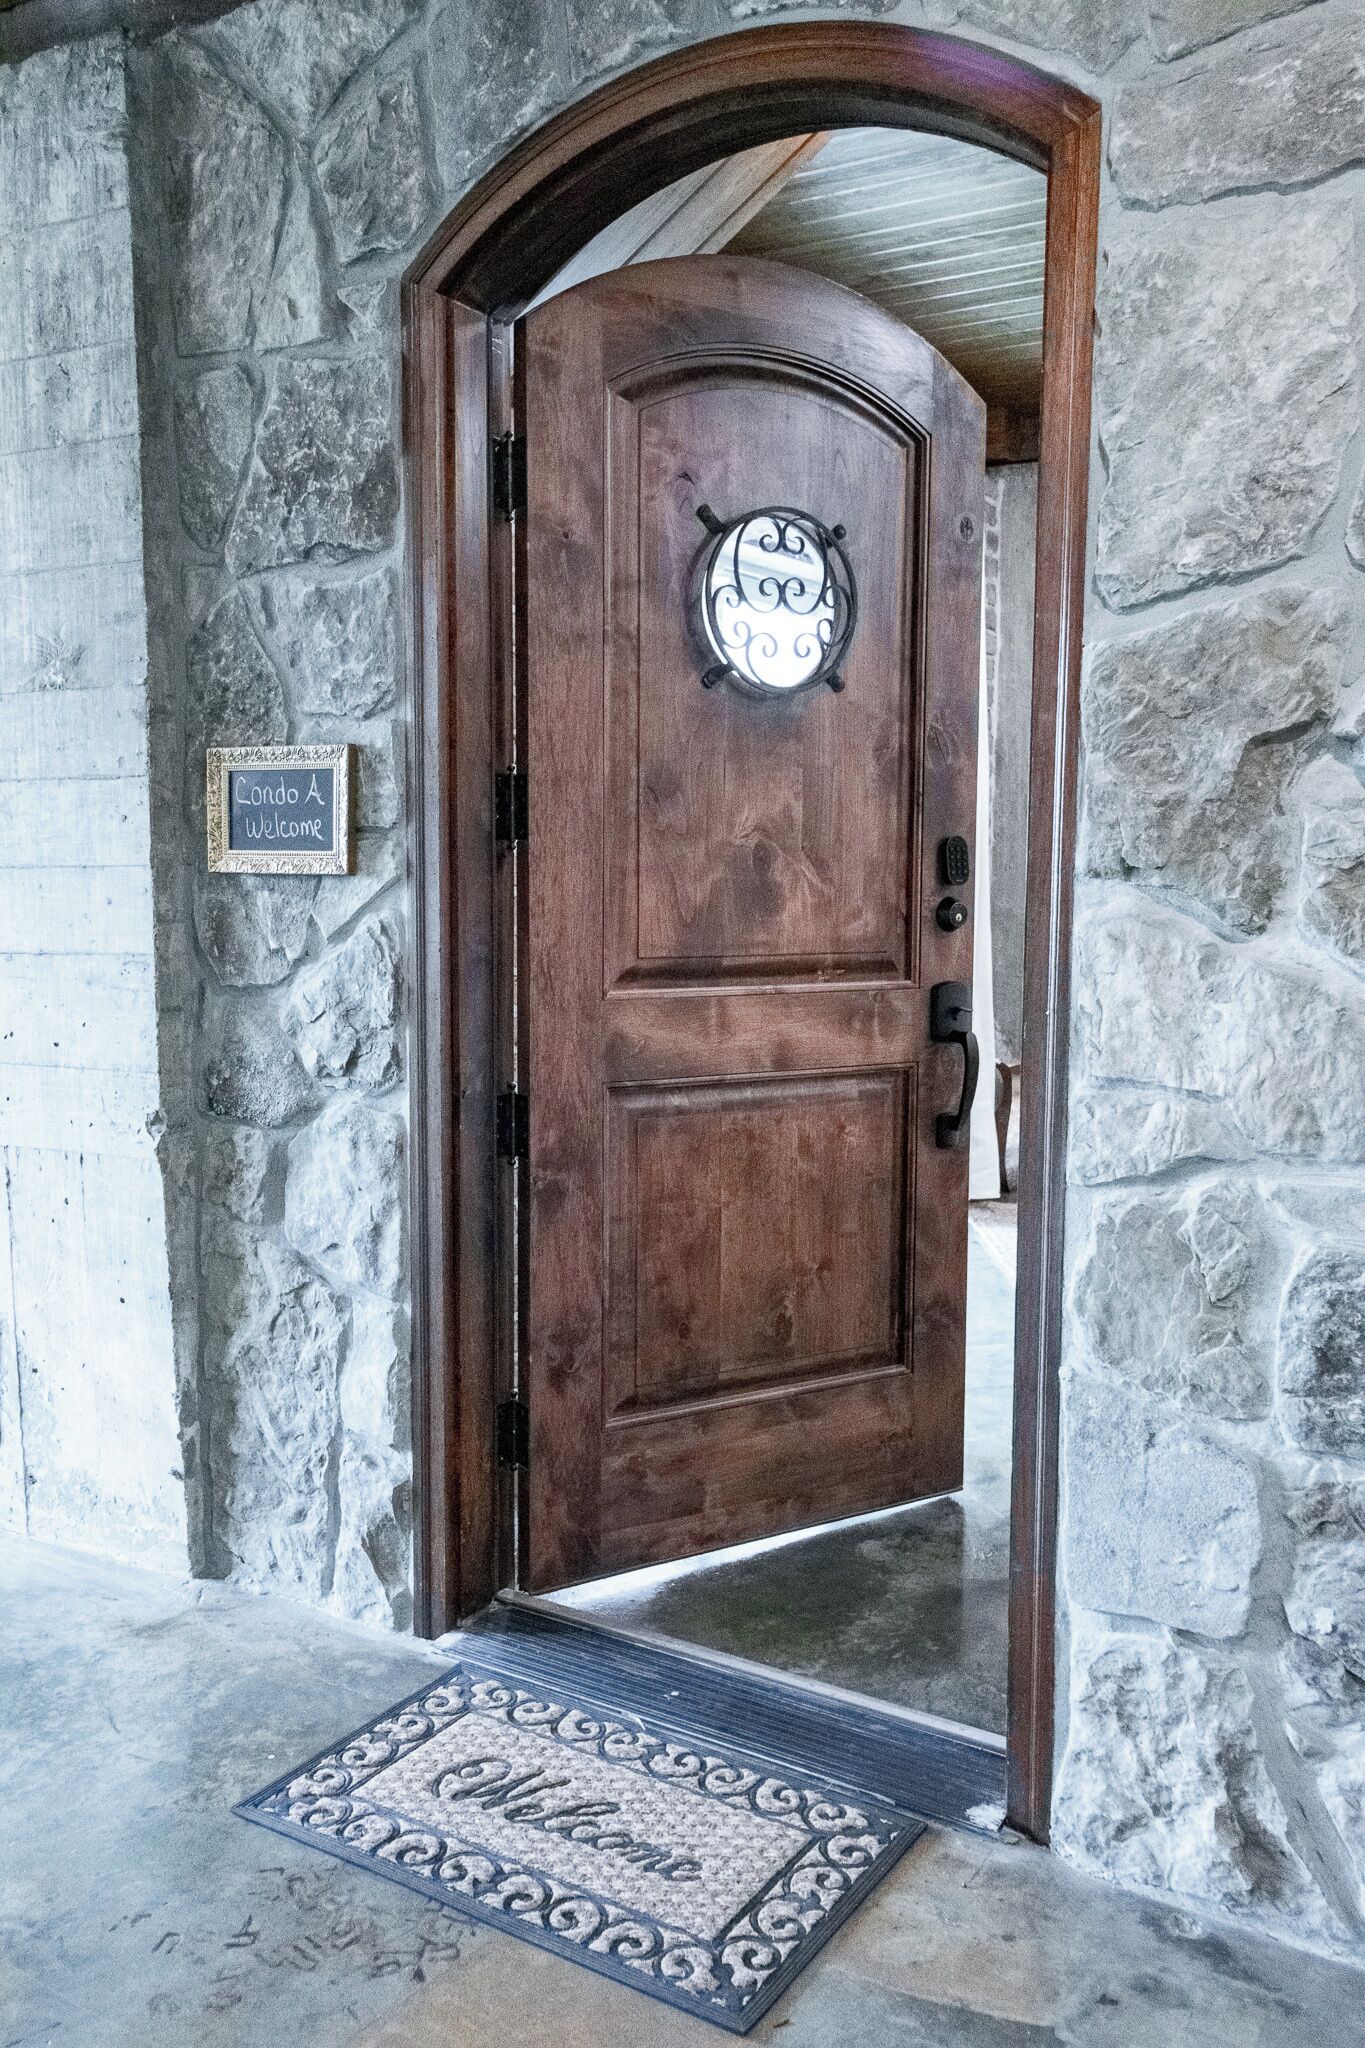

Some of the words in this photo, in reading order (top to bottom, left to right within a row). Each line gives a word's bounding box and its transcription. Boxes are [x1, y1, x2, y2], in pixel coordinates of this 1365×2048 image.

[236, 777, 298, 806] Condo
[305, 774, 325, 805] A
[245, 812, 324, 841] Welcome
[431, 1757, 703, 1882] Welcome
